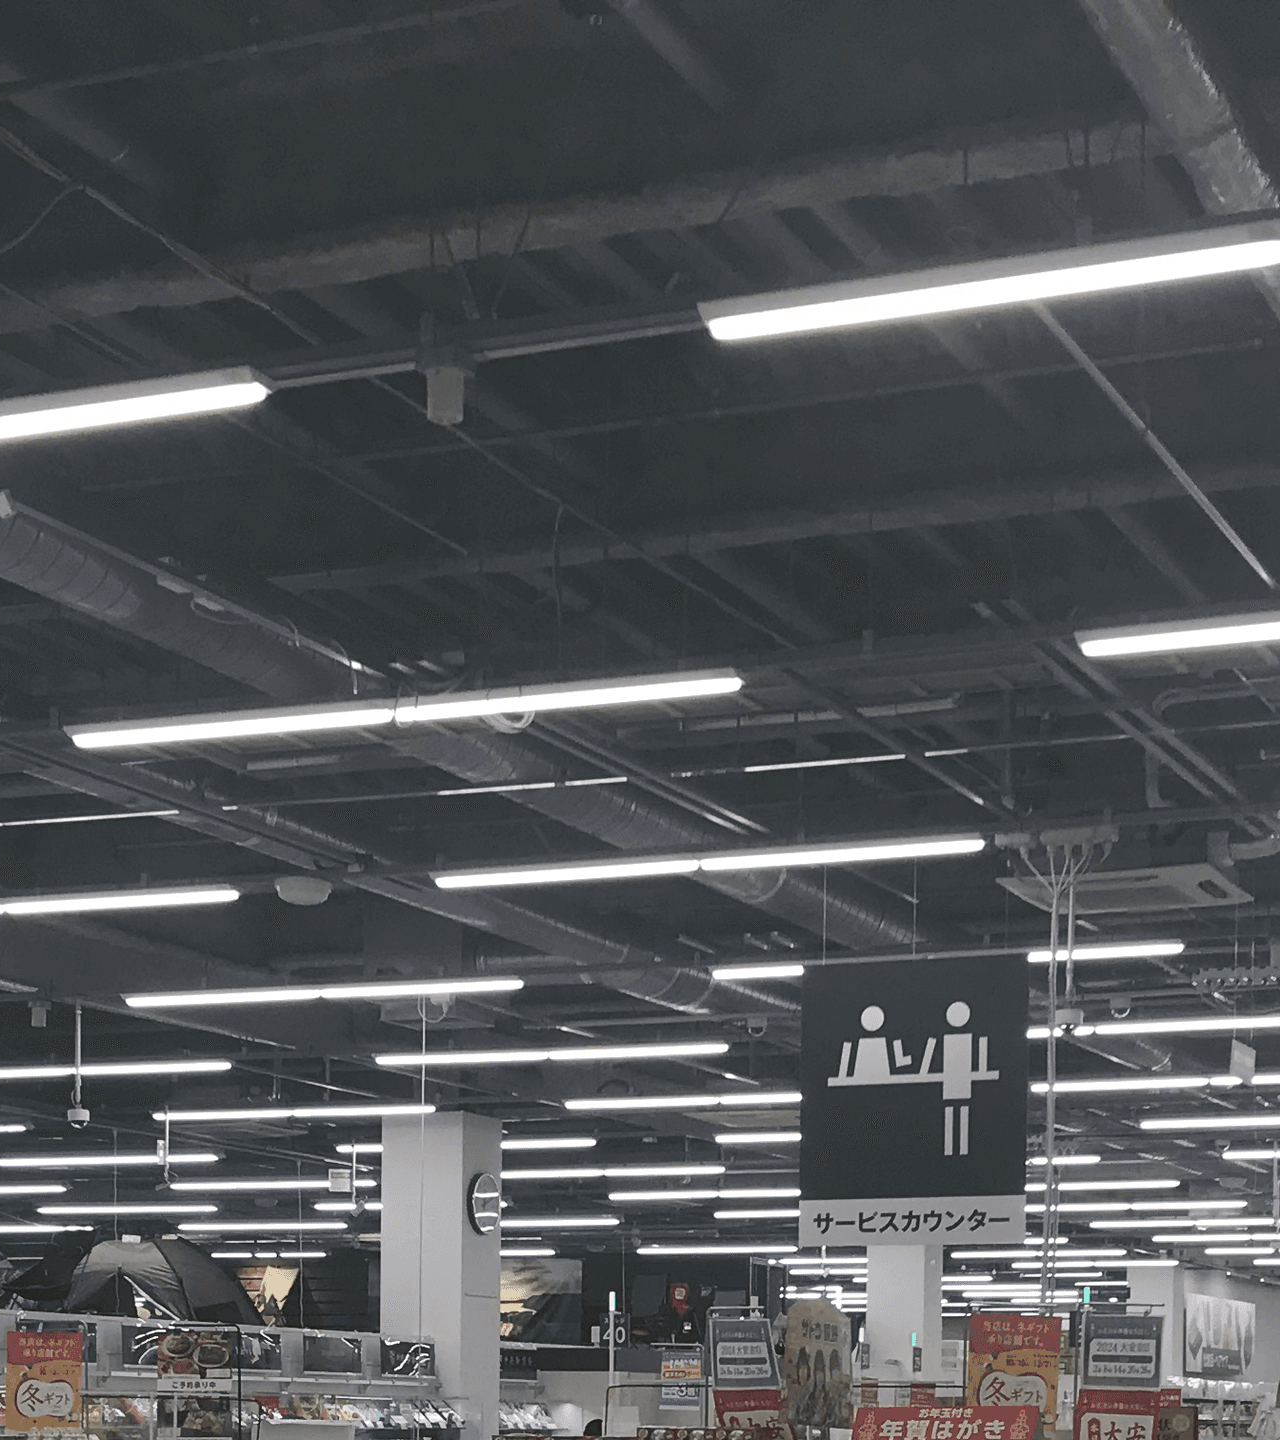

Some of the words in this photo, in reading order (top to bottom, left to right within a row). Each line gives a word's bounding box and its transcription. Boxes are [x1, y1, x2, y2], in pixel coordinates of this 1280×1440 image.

[813, 1210, 1010, 1234] サービスカウンター
[602, 1326, 626, 1344] 40
[1097, 1342, 1118, 1352] 2024
[21, 1384, 71, 1411] 冬ギフト
[984, 1377, 1044, 1406] 冬ギフト
[919, 1408, 974, 1418] お年玉付き
[879, 1419, 1006, 1440] 年賀はがき
